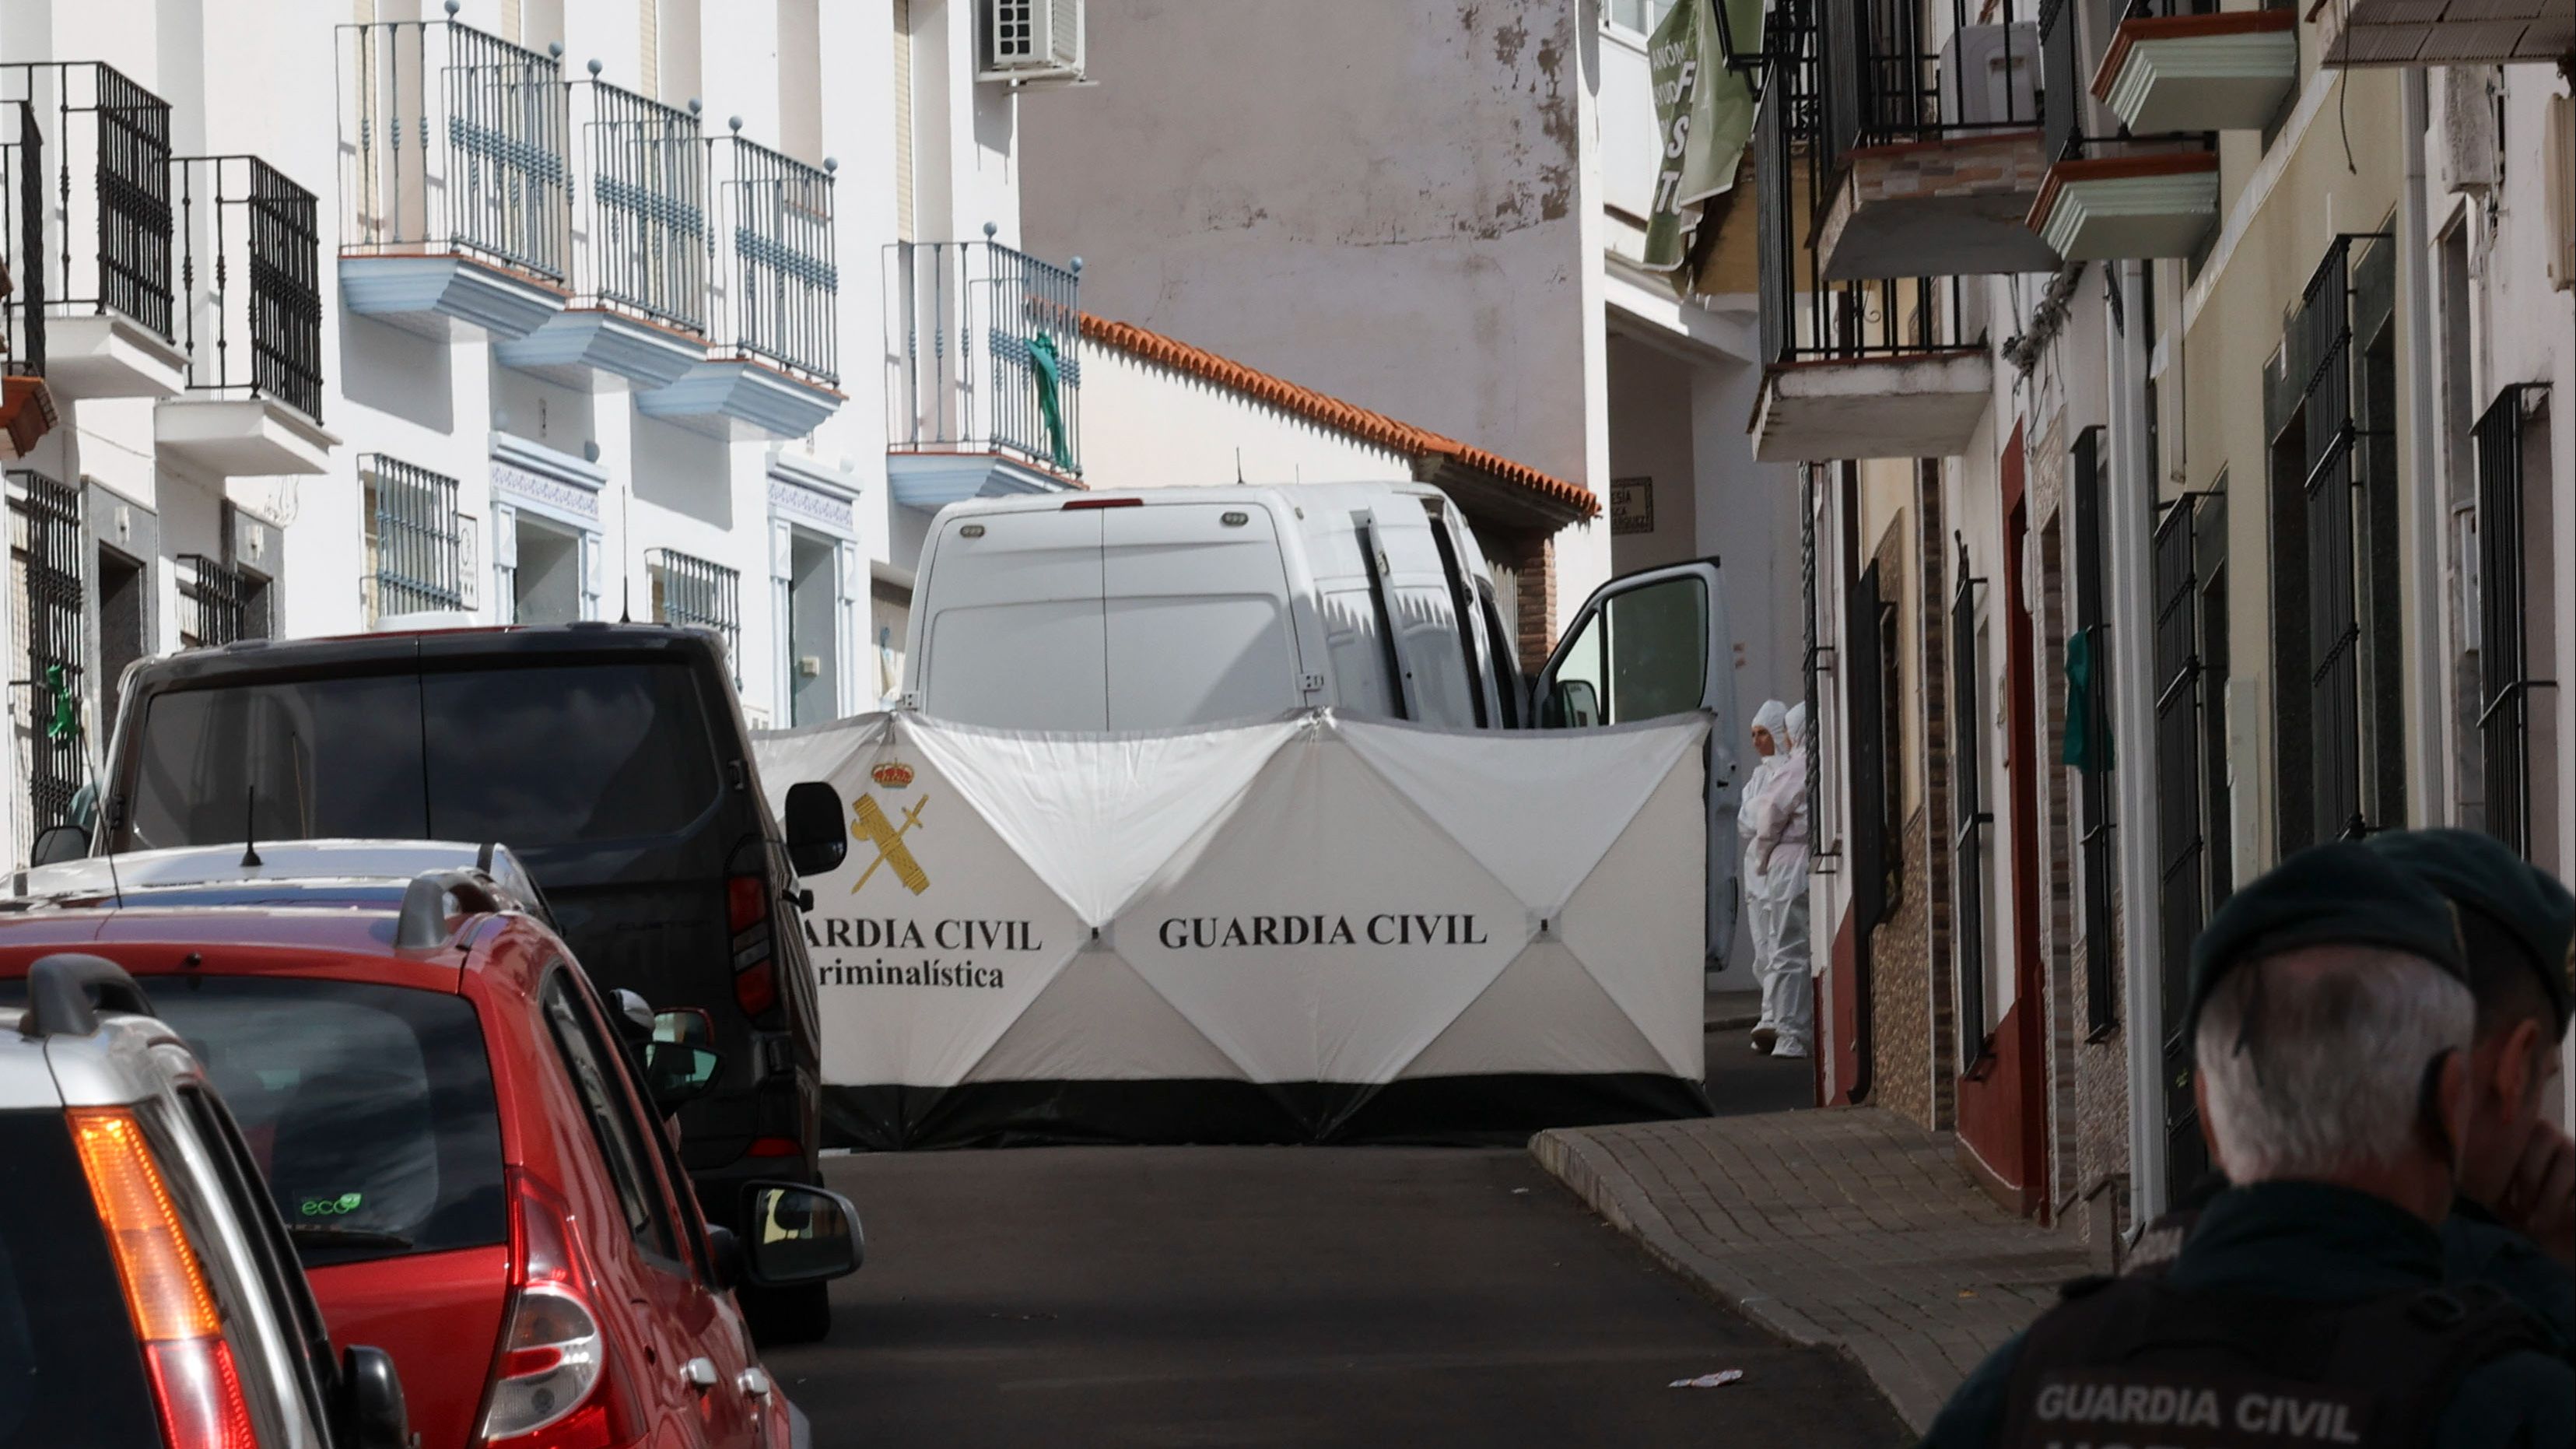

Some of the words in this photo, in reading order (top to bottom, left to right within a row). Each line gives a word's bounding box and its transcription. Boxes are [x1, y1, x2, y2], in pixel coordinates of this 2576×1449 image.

[804, 917, 926, 949] ARDIA
[934, 918, 1043, 951] CIVIL
[1158, 914, 1356, 949] GUARDIA
[1367, 914, 1488, 946] CIVIL
[818, 957, 1004, 988] riminalística
[302, 1198, 350, 1216] eco
[2036, 1382, 2221, 1429] GUARDIA
[2234, 1392, 2360, 1444] CIVIL
